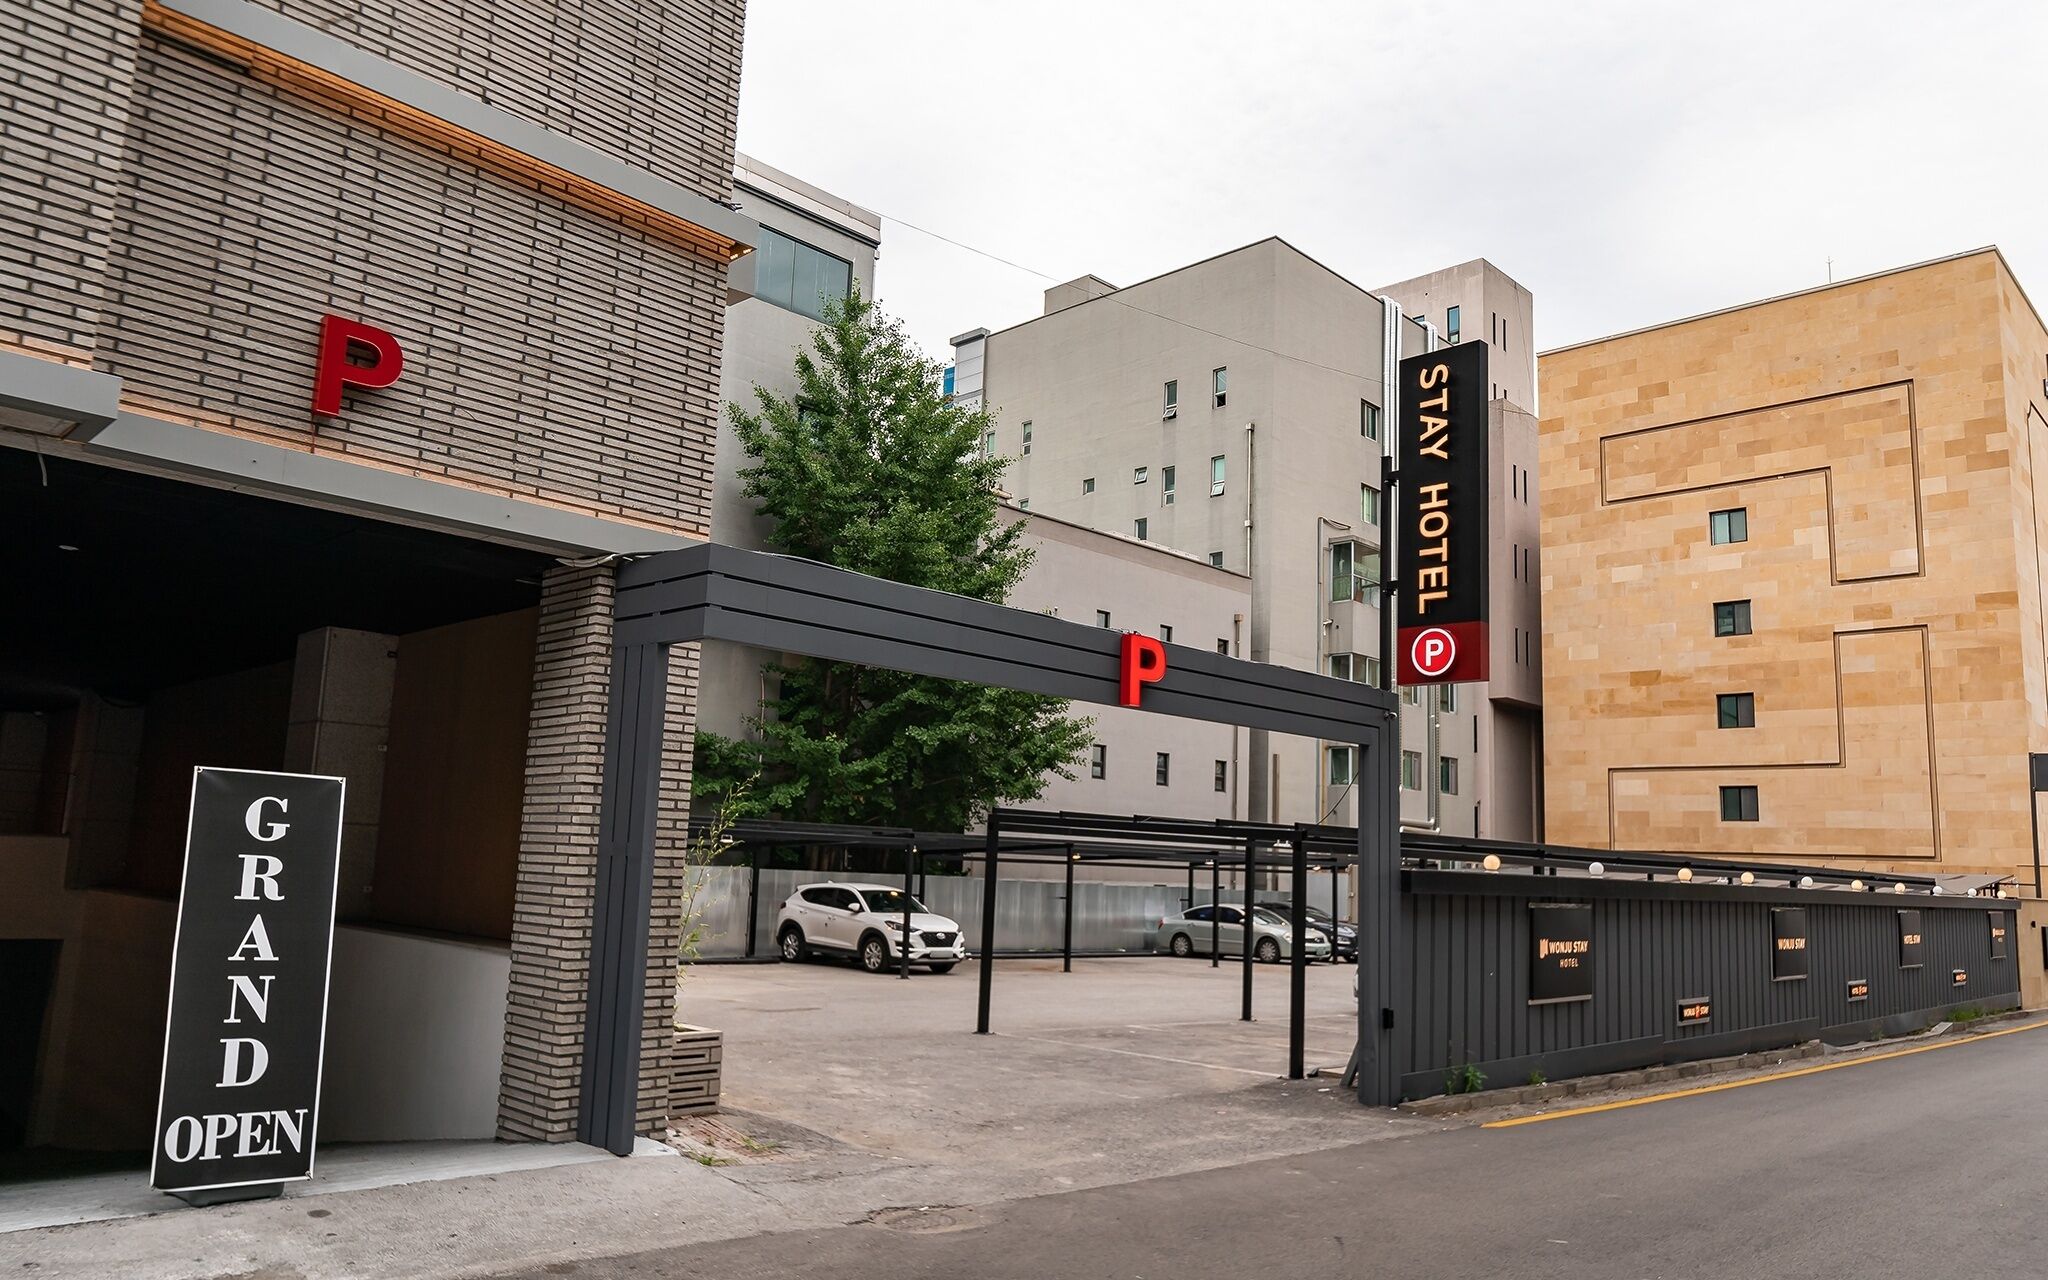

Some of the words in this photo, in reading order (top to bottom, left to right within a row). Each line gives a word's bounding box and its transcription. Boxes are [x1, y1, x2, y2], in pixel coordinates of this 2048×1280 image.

[312, 313, 404, 417] P
[1418, 362, 1449, 460] STAY
[1418, 482, 1449, 615] HOTEL
[1120, 633, 1167, 708] P
[215, 796, 290, 1088] GRAND
[1549, 941, 1573, 954] WONJU
[1573, 940, 1589, 953] STAY
[1559, 957, 1579, 968] HOTEL
[164, 1108, 309, 1163] OPEN
